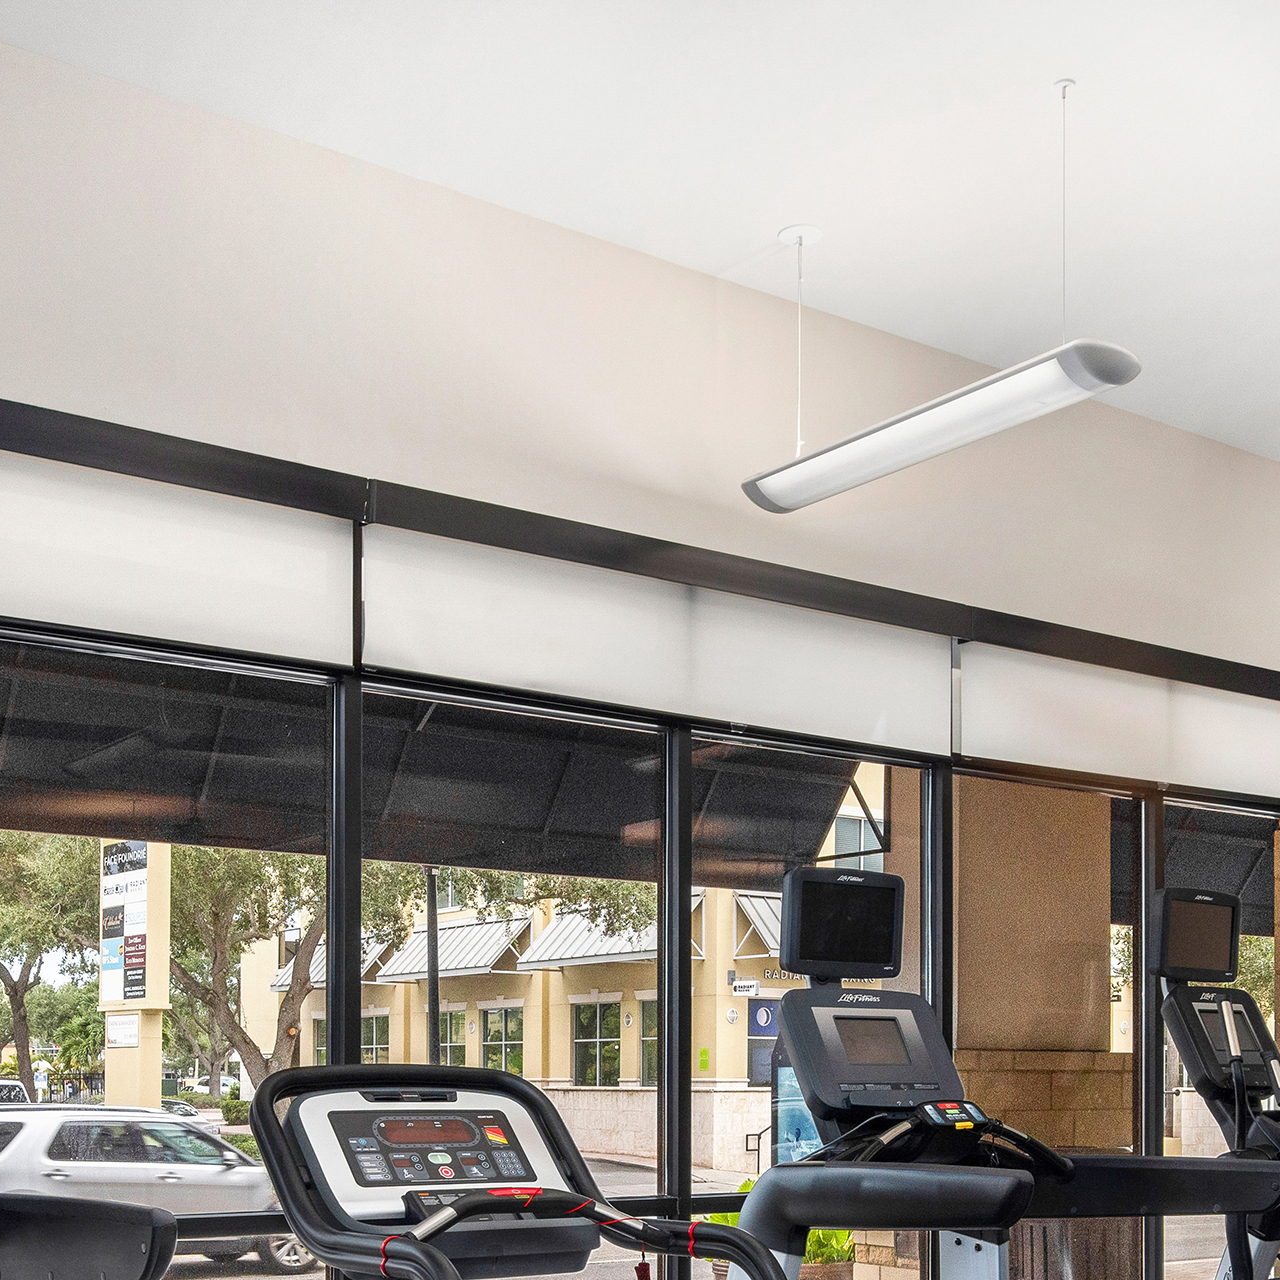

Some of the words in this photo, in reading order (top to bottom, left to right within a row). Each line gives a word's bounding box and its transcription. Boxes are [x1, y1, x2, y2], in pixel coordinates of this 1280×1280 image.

[104, 854, 118, 866] FACE
[838, 993, 854, 1003] Life
[852, 994, 881, 1004] Fitness
